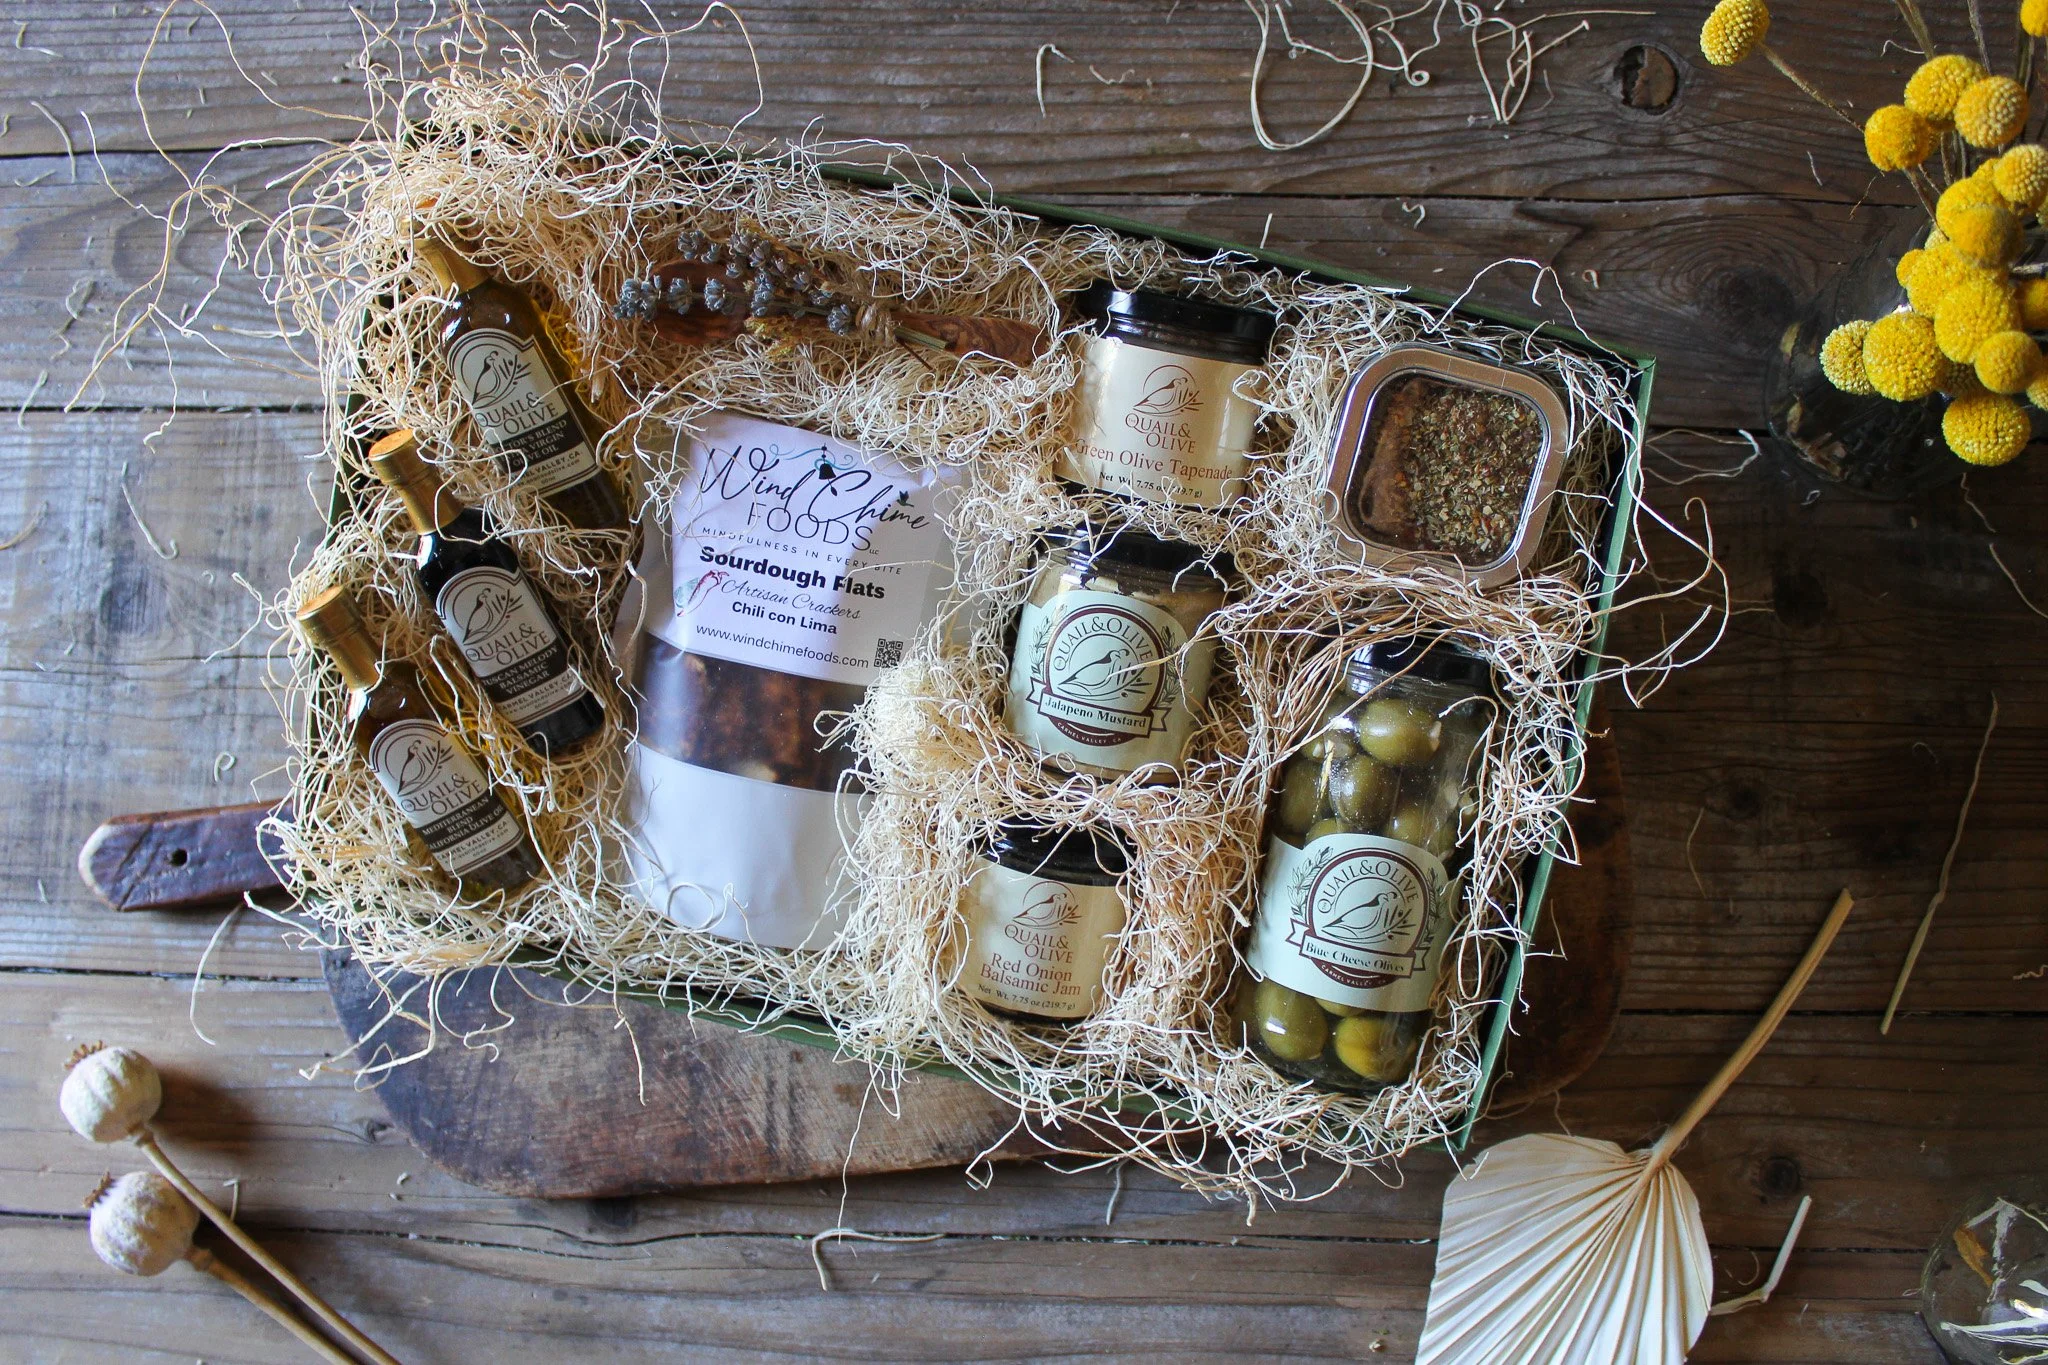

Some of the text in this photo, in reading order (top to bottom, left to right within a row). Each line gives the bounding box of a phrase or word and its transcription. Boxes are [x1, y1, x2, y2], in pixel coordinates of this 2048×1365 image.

[474, 391, 543, 428] QUAIL&
[503, 402, 559, 435] OLIVE
[529, 430, 565, 450] VIRGIN
[535, 420, 567, 439] BLEND
[1125, 412, 1191, 439] QUAIL&
[541, 444, 559, 456] OIL
[1146, 432, 1196, 454] OLIVE
[1075, 438, 1233, 482] Green Olive Tapenade
[700, 445, 930, 530] Wind Chime
[1100, 471, 1113, 482] Net
[1136, 479, 1154, 490] 7.75
[747, 502, 874, 552] FOODS
[703, 527, 902, 576] MINDFULNESS IN EVERY BITE
[699, 546, 885, 600] Sourdough Flats
[721, 579, 861, 620] Artisan Crackers
[731, 602, 838, 635] Chili con Lima
[465, 622, 536, 663] QUAIL&
[496, 630, 551, 666] OLIVE
[696, 624, 869, 669] www.windchimefoods.com
[518, 647, 558, 670] MELODY
[499, 661, 550, 689] BALSAMIC
[505, 670, 550, 695] VINEGAR
[499, 697, 527, 711] ARMEL
[1045, 696, 1147, 728] Jalapeno Mustard
[1057, 722, 1079, 738] CARMEL
[400, 772, 470, 813] QUAIL&
[431, 779, 484, 816] OLIVE
[421, 796, 489, 835] MEDITERRANEAN
[446, 816, 474, 834] BLEND
[427, 828, 470, 850] ALIFORNIA
[468, 814, 495, 831] OLIVE
[1004, 924, 1069, 950] QUAIL&
[991, 952, 1072, 982] Red Onion
[1024, 944, 1074, 964] OLIVE
[1332, 950, 1371, 968] Cheese
[1374, 959, 1404, 972] Olives
[980, 963, 1081, 996] Balsamic Jam
[1321, 964, 1345, 982] CARMEL
[978, 984, 991, 995] Net
[1012, 994, 1028, 1004] 7.75
[1041, 1000, 1067, 1009] (219.7
